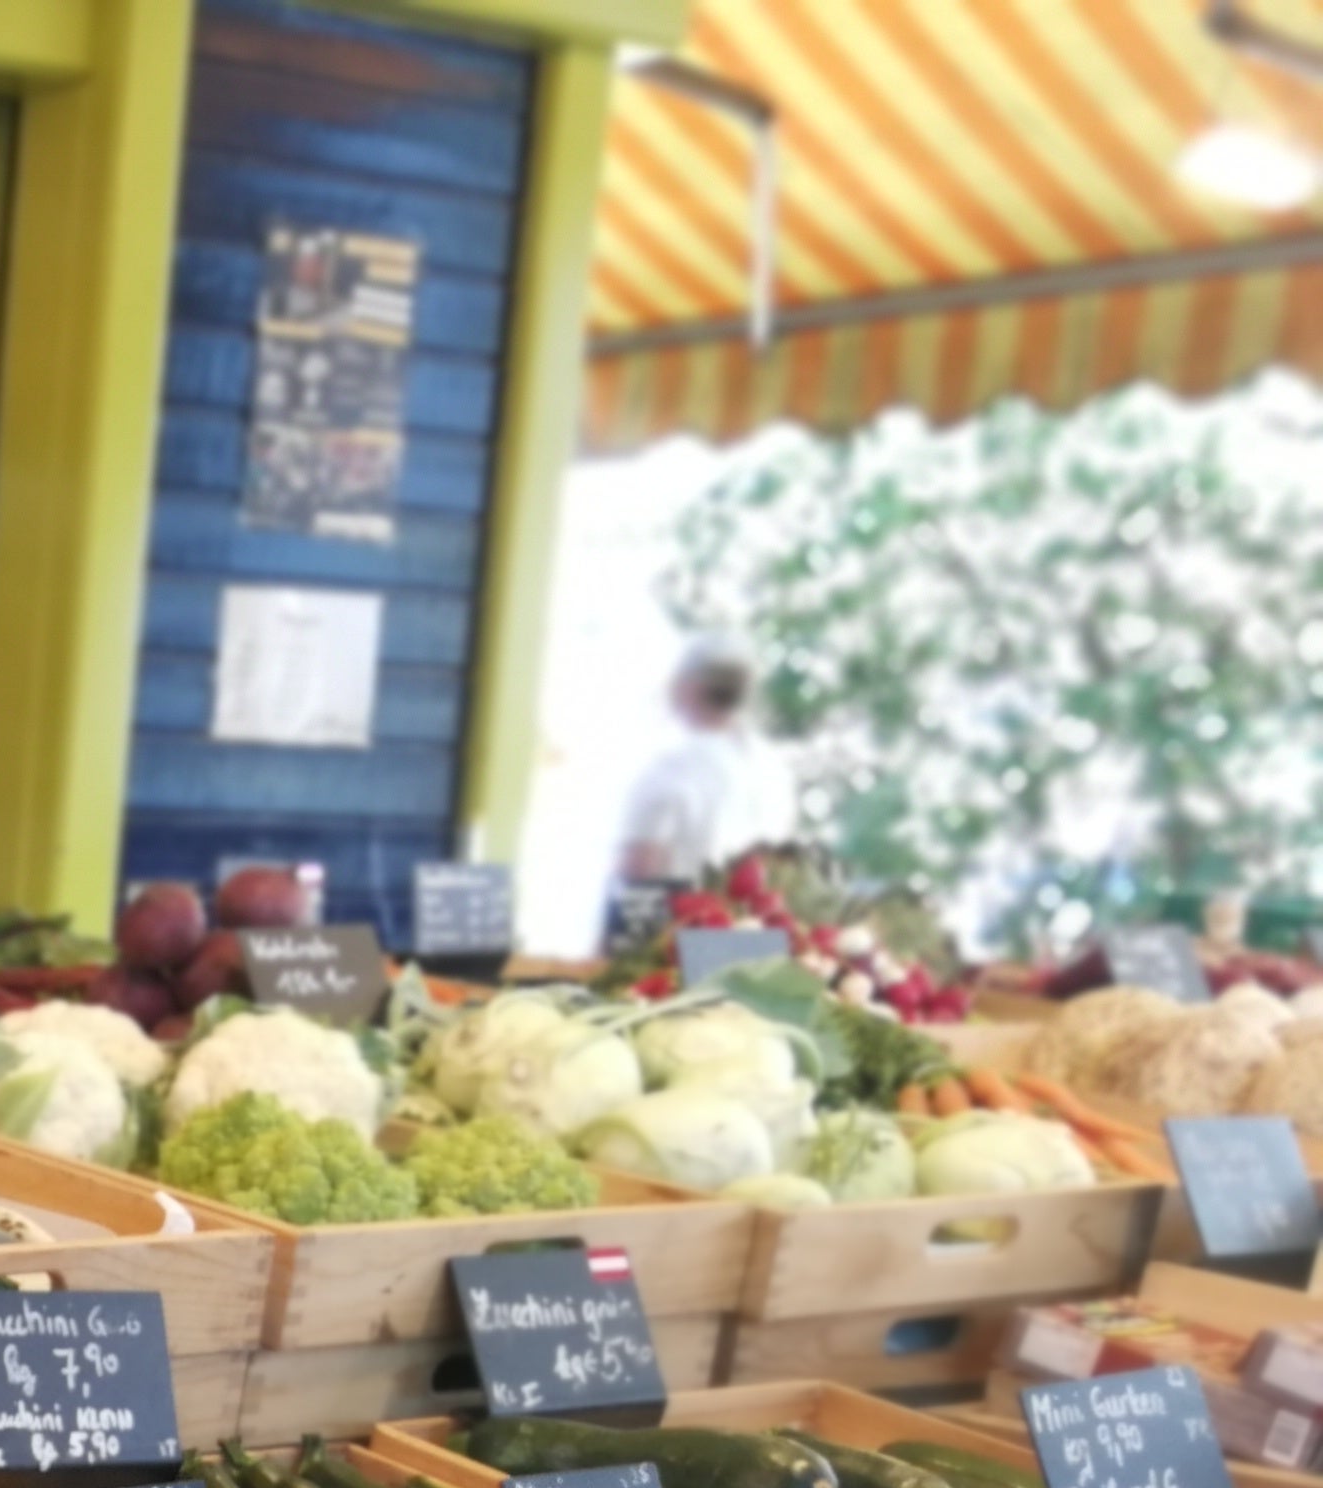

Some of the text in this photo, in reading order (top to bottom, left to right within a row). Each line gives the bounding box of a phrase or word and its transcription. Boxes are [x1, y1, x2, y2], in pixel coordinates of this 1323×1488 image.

[52, 1341, 120, 1399] 7,90
[1030, 1383, 1167, 1436] Mini Gurken
[68, 1430, 121, 1464] 5,90
